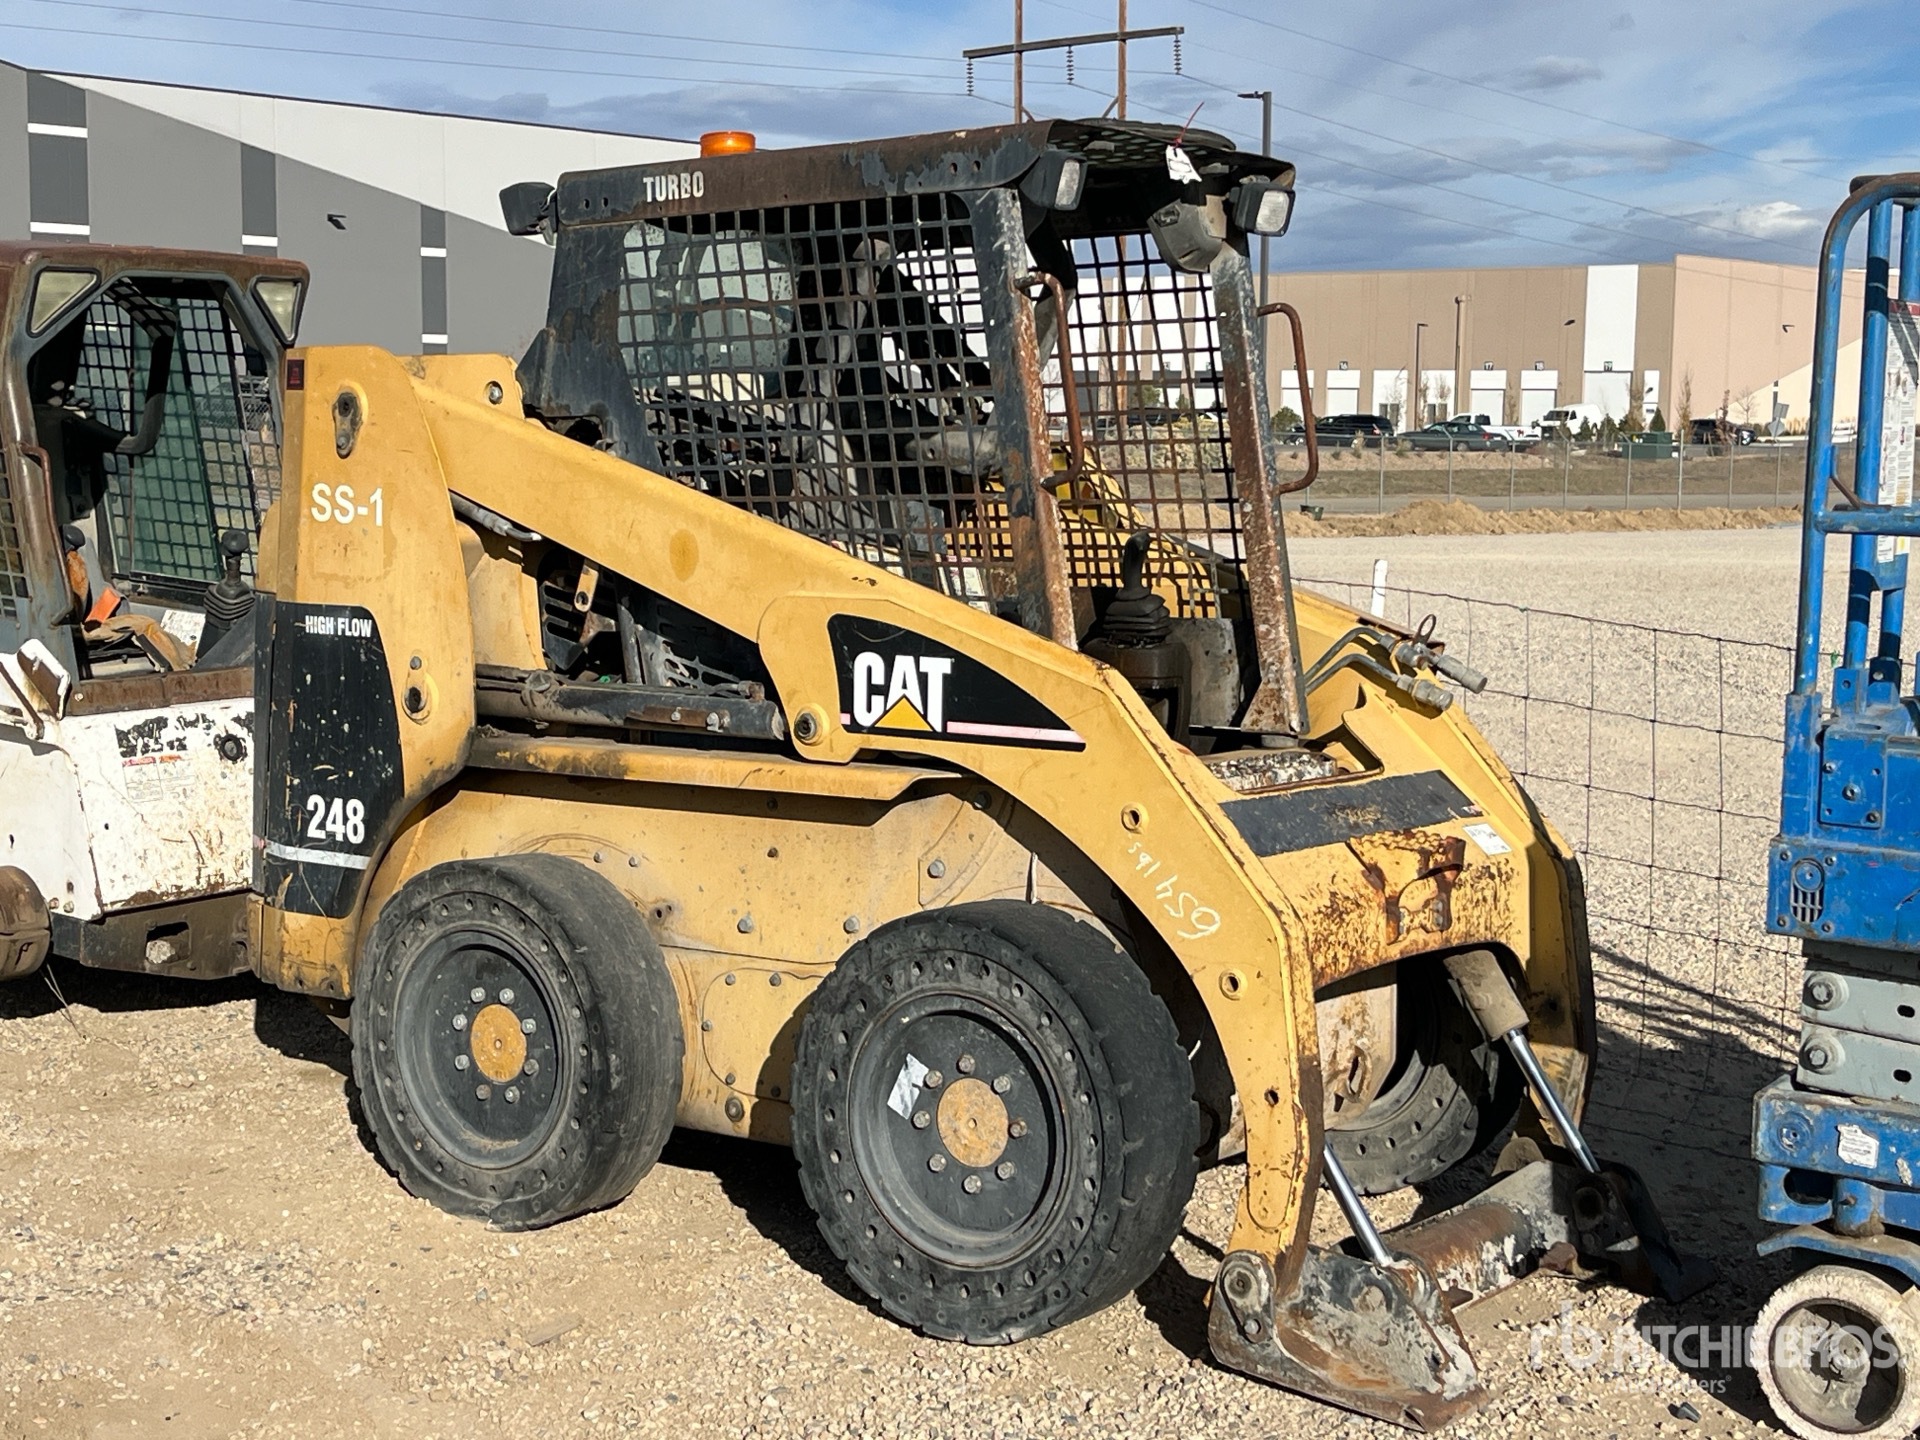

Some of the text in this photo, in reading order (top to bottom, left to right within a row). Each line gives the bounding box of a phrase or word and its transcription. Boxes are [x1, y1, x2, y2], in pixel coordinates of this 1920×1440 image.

[643, 171, 704, 203] TURBO
[311, 483, 383, 527] SS-1
[305, 615, 372, 638] HIGH FLOW
[853, 651, 952, 733] CAT
[307, 794, 365, 845] 248
[1155, 874, 1221, 940] 654
